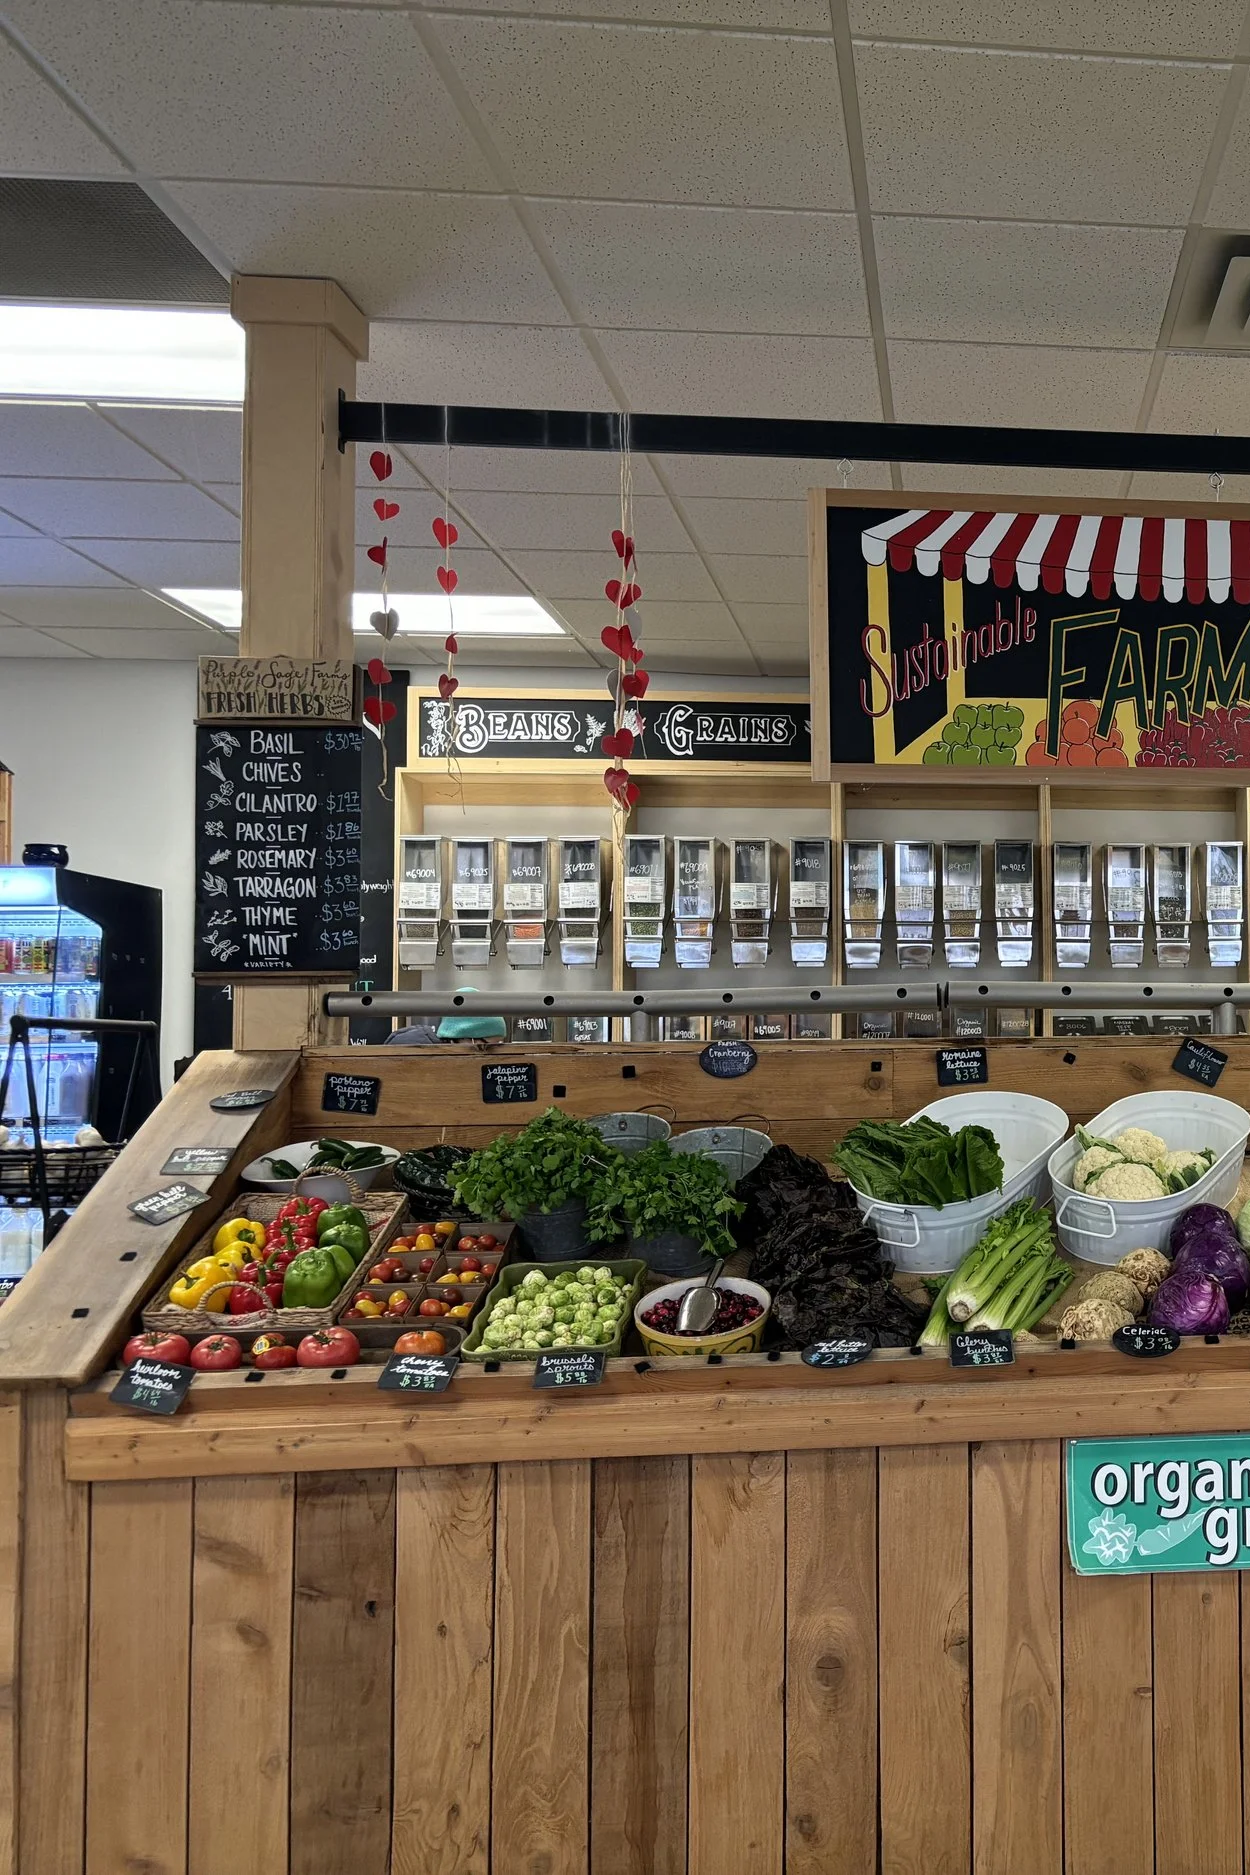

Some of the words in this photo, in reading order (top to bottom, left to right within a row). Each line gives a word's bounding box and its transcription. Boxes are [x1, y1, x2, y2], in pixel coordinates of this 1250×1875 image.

[859, 595, 1037, 719] Sustainable
[204, 660, 255, 684] Purple
[261, 661, 304, 688] Sage
[311, 662, 350, 686] Farms
[206, 691, 257, 713] FRESH
[267, 692, 325, 716] HERBS
[456, 703, 571, 753] BEANS
[664, 704, 791, 756] GRAINS
[250, 730, 304, 754] BASIL
[242, 762, 302, 783] CHIVES
[235, 793, 318, 813] CILANTRO
[236, 823, 308, 842] PARSLEY
[237, 848, 317, 869] ROSEMARY
[233, 876, 317, 898] TARRAGON
[241, 906, 298, 926] THYME
[709, 1048, 753, 1064] Cranberry
[329, 1076, 375, 1088] poblano
[495, 1074, 528, 1084] pepper
[336, 1085, 372, 1097] pepper
[956, 1336, 991, 1348] Celery
[130, 1359, 181, 1379] heirloom
[540, 1354, 595, 1366] brussels
